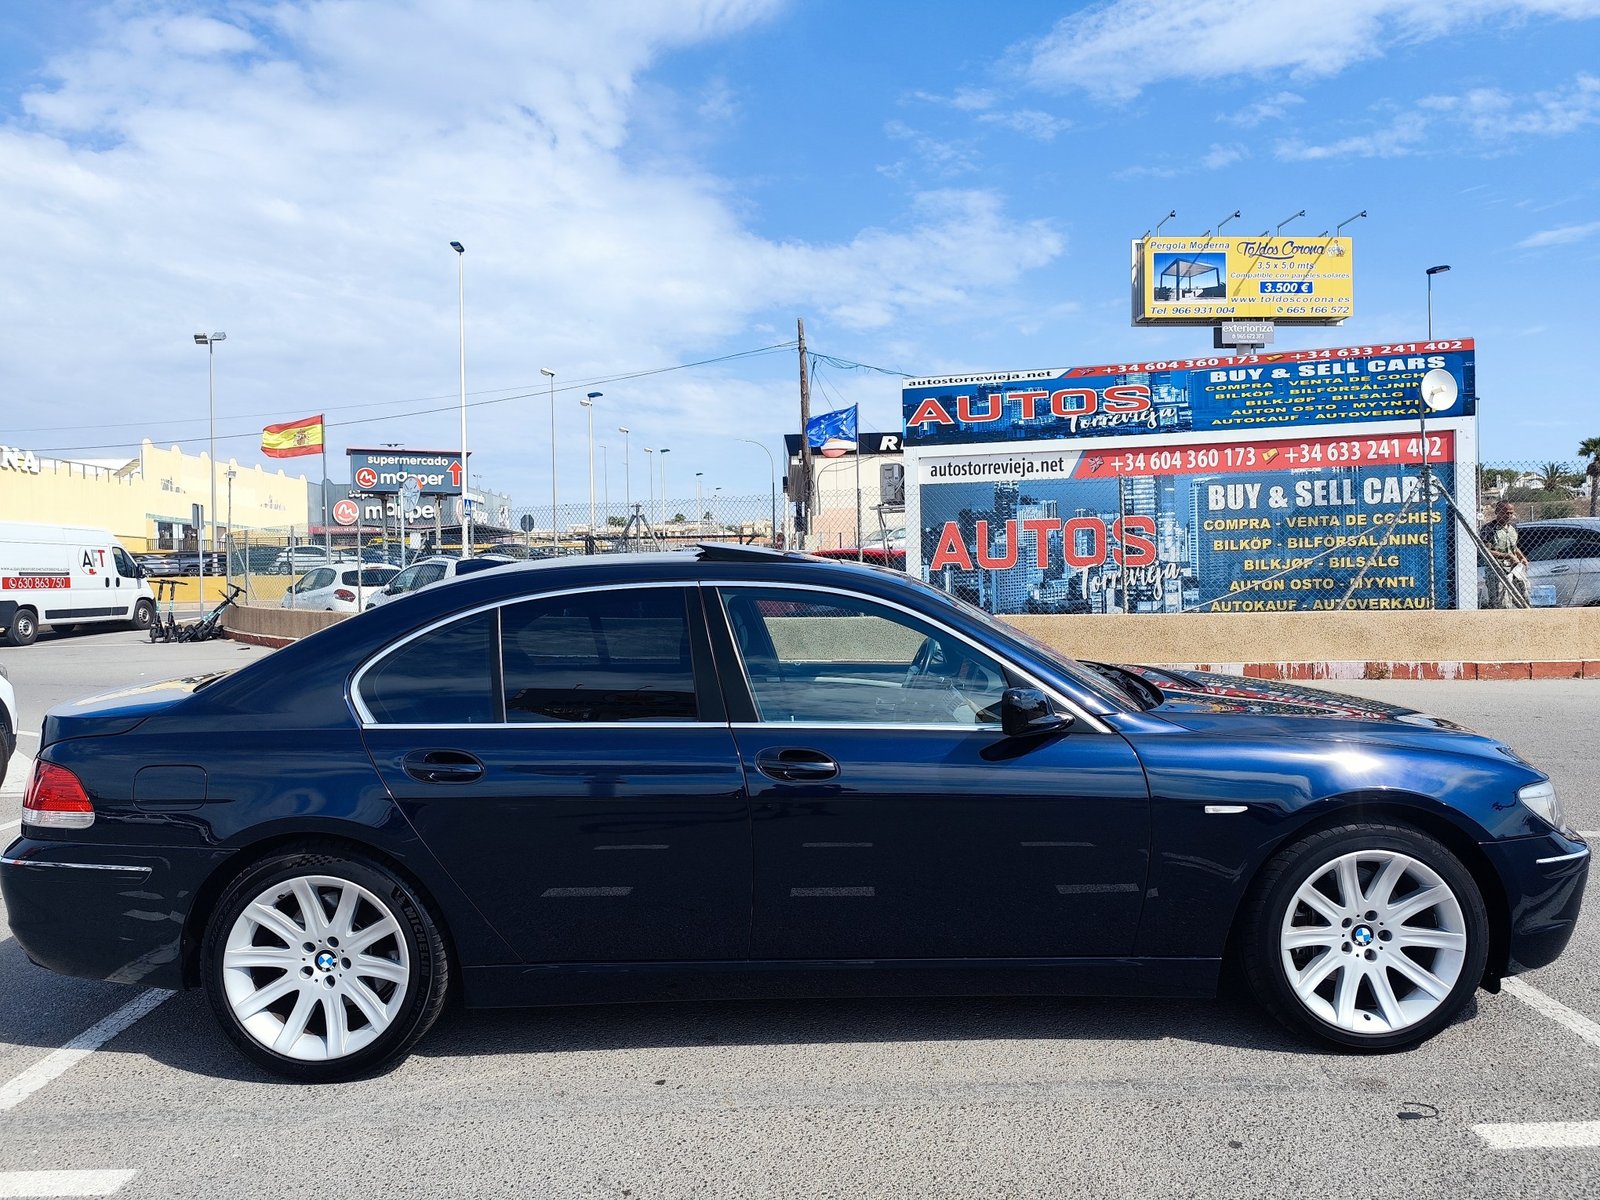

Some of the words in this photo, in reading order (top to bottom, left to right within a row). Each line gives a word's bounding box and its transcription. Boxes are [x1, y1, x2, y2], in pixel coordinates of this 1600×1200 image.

[1150, 241, 1186, 250] Pergola
[1189, 241, 1230, 249] Moderna
[1236, 241, 1279, 259] Toldos
[1281, 240, 1325, 256] Corona
[1264, 282, 1298, 293] 3.500
[1300, 282, 1310, 293] €
[1194, 306, 1212, 314] 931
[1216, 306, 1235, 314] 004
[1286, 306, 1306, 314] 665
[1310, 306, 1328, 314] 166
[1330, 306, 1350, 314] 572
[1222, 323, 1274, 333] exterioriza
[1291, 350, 1331, 360] +34
[1336, 346, 1373, 357] 633
[1379, 343, 1416, 354] 241
[1423, 340, 1463, 351] 402
[1102, 364, 1140, 374] +34
[1144, 361, 1179, 371] 604
[1184, 357, 1219, 368] 360
[1225, 355, 1259, 366] 173
[1210, 368, 1264, 383] BUY
[1271, 368, 1291, 379] &
[1298, 361, 1360, 377] SELL
[1367, 355, 1446, 373] CARS
[907, 370, 1053, 388] autostorrevieja.net
[1204, 382, 1273, 392] COMPRA
[1288, 377, 1343, 386] VENTA
[1349, 375, 1371, 383] DE
[1215, 390, 1274, 400] BILKÖP
[1331, 391, 1404, 401] BILSALG
[906, 384, 1152, 428] AUTOS
[1231, 407, 1287, 416] AUTON
[1292, 404, 1337, 412] OSTO
[1352, 399, 1420, 409] MYYNTI
[1068, 408, 1176, 433] Torrevieja
[1211, 415, 1299, 425] AUTOKAUF
[1284, 443, 1322, 463] +34
[1327, 440, 1361, 461] 633
[1366, 438, 1400, 460] 241
[1406, 436, 1442, 457] 402
[367, 455, 449, 467] supermercado
[930, 456, 1065, 479] autostorrevieja.net
[1110, 452, 1146, 472] +34
[1149, 450, 1182, 471] 604
[1186, 447, 1219, 469] 360
[1224, 446, 1257, 467] 173
[1208, 483, 1262, 511] BUY
[1268, 485, 1288, 509] &
[1295, 478, 1356, 508] SELL
[1203, 517, 1272, 531] COMPRA
[1286, 515, 1341, 528] VENTA
[1345, 513, 1368, 526] DE
[930, 515, 1157, 571] AUTOS
[1213, 536, 1273, 551] BILKÖP
[83, 550, 105, 568] AFT
[1329, 555, 1400, 569] BILSALG
[18, 578, 33, 588] 630
[34, 578, 50, 588] 863
[51, 577, 66, 588] 750
[1229, 579, 1285, 592] AUTON
[1290, 578, 1335, 591] OSTO
[1210, 599, 1298, 612] AUTOKAUF
